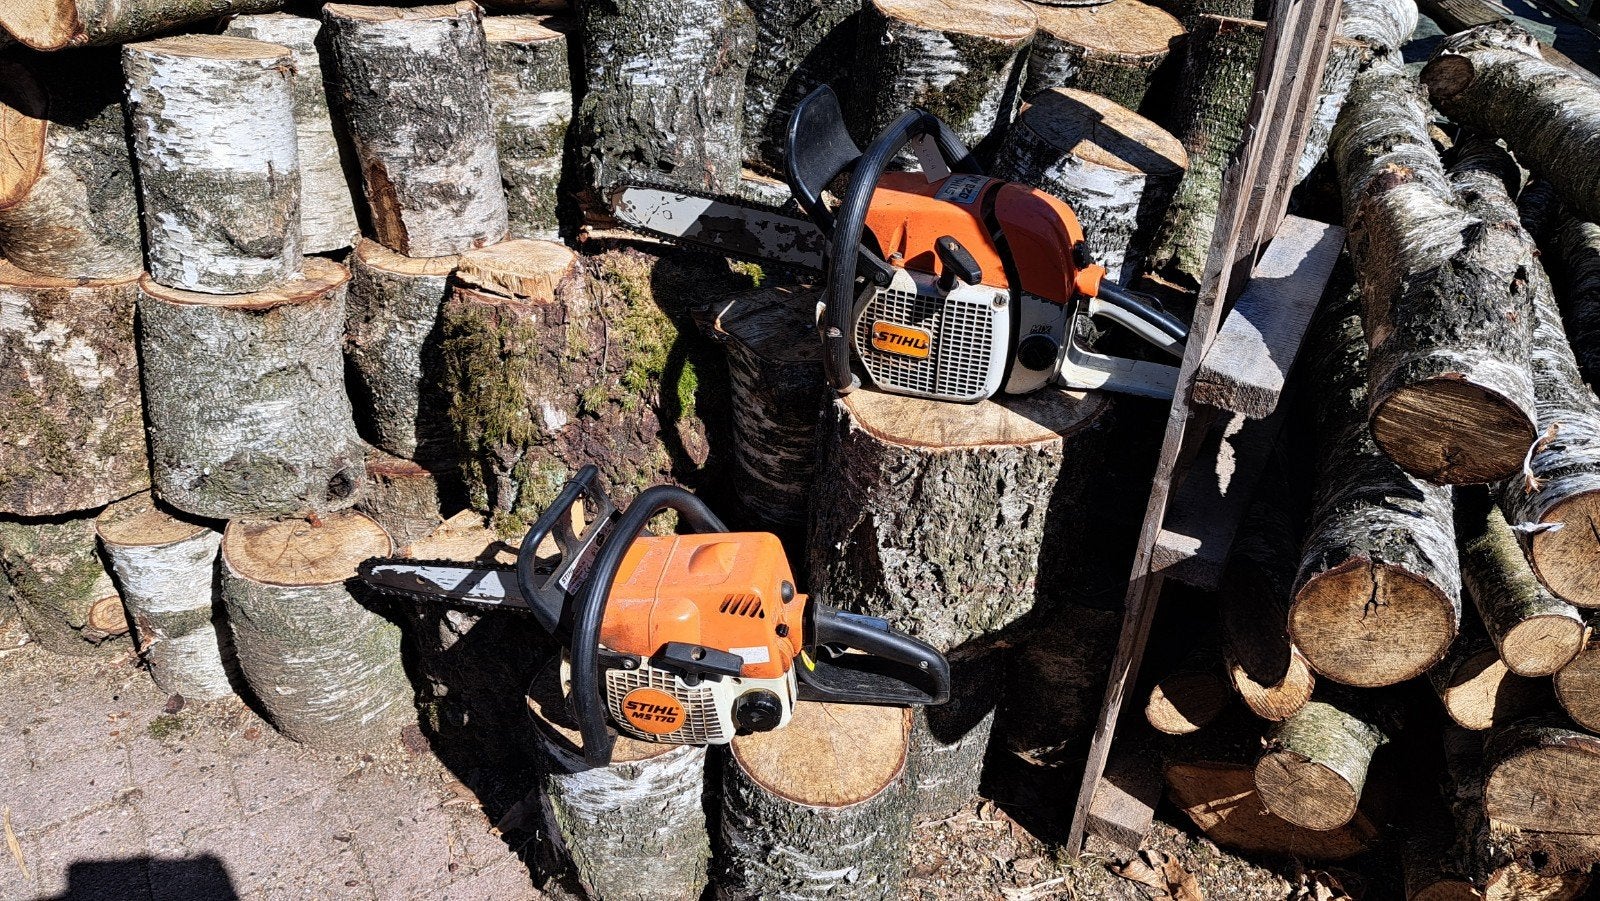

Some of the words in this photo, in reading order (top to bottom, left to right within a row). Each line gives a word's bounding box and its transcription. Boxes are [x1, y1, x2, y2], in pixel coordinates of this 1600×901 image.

[877, 331, 927, 349] STIHL
[625, 701, 679, 716] STIHL
[631, 712, 653, 721] MS
[654, 715, 677, 723] 170
